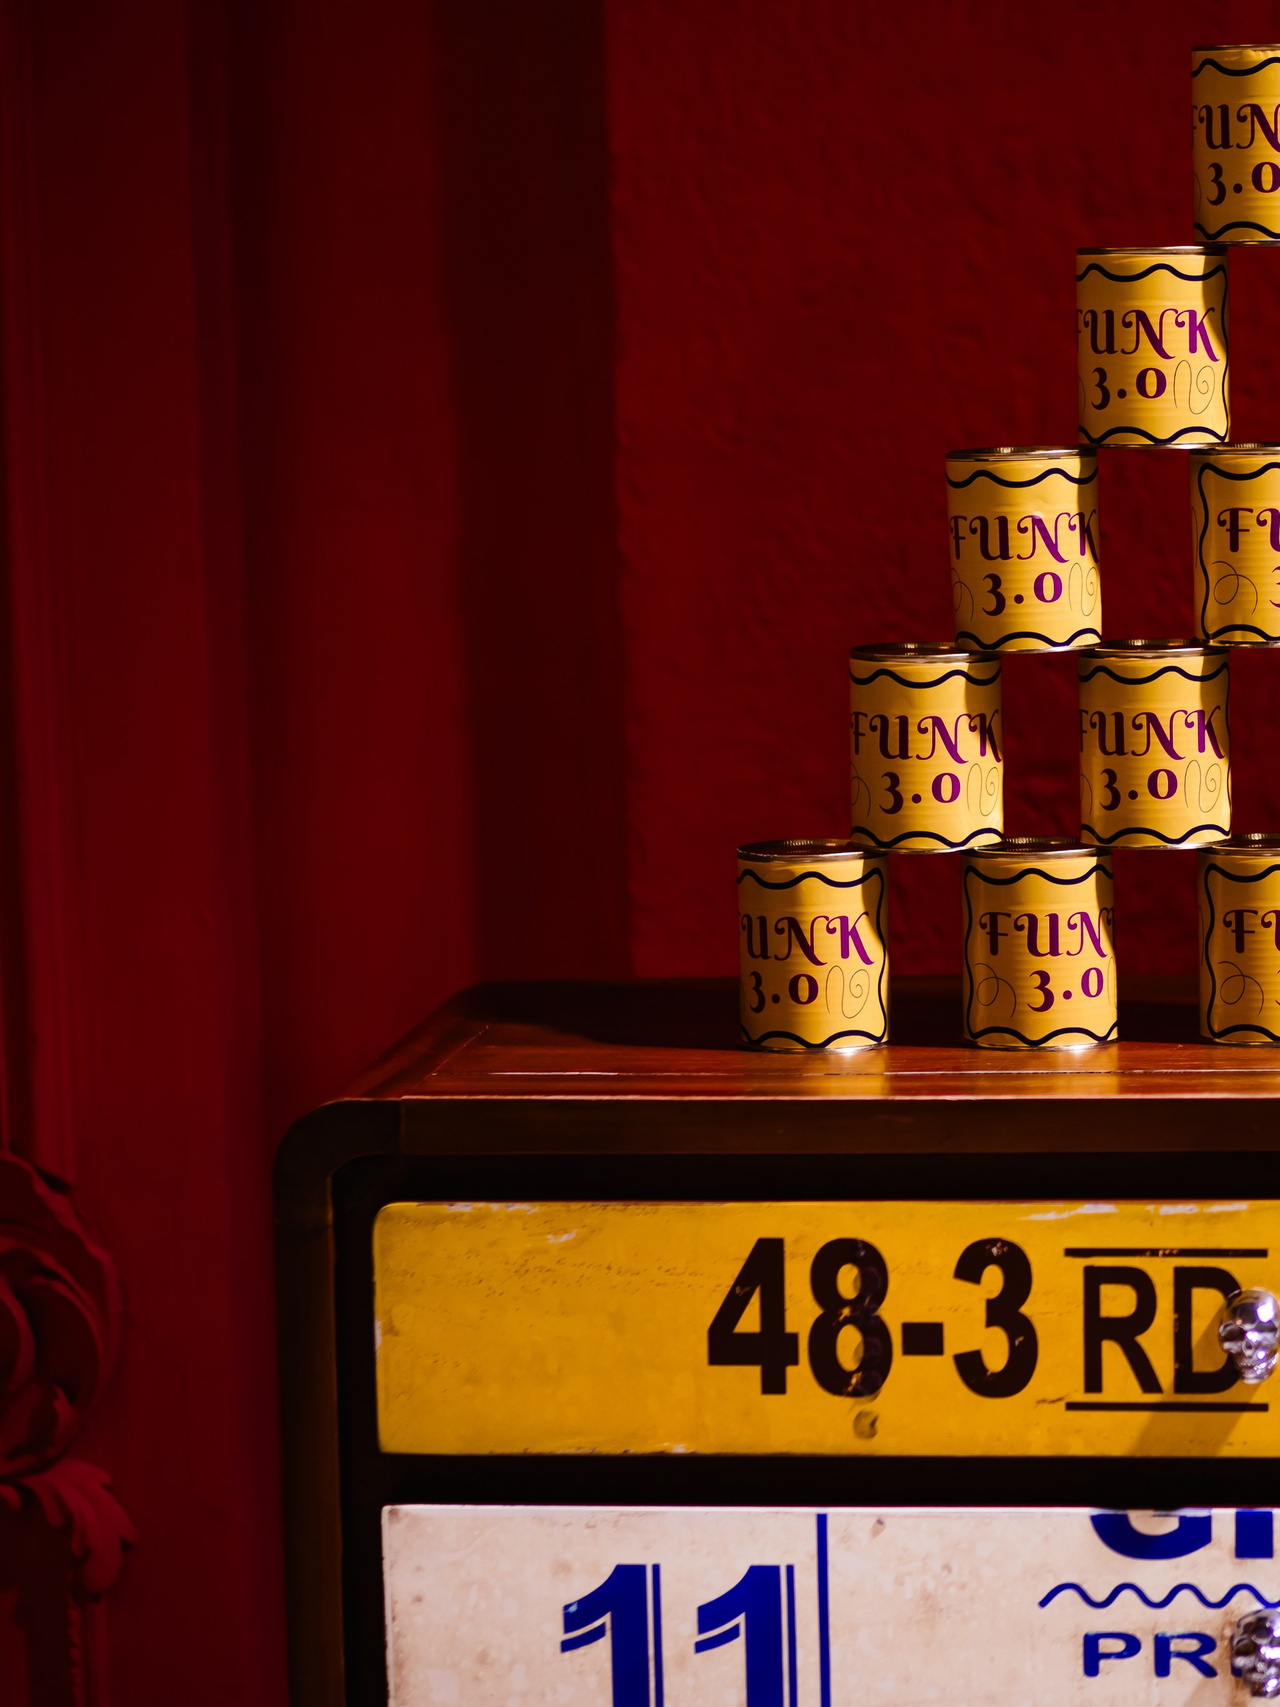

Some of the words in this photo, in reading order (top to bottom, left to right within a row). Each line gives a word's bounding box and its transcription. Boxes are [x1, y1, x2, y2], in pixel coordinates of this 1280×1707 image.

[1090, 367, 1167, 410] 3.0
[950, 509, 1099, 563] FUNK
[982, 572, 1063, 616] 3.0
[851, 708, 1002, 764] FUNK
[879, 771, 961, 815] 3.0
[1099, 768, 1178, 811] 3.0
[738, 911, 876, 966] UNK
[748, 971, 820, 1013] 3.0
[1027, 967, 1104, 1012] 3.0
[707, 1237, 1039, 1399] 48-3
[1084, 1265, 1243, 1394] RD
